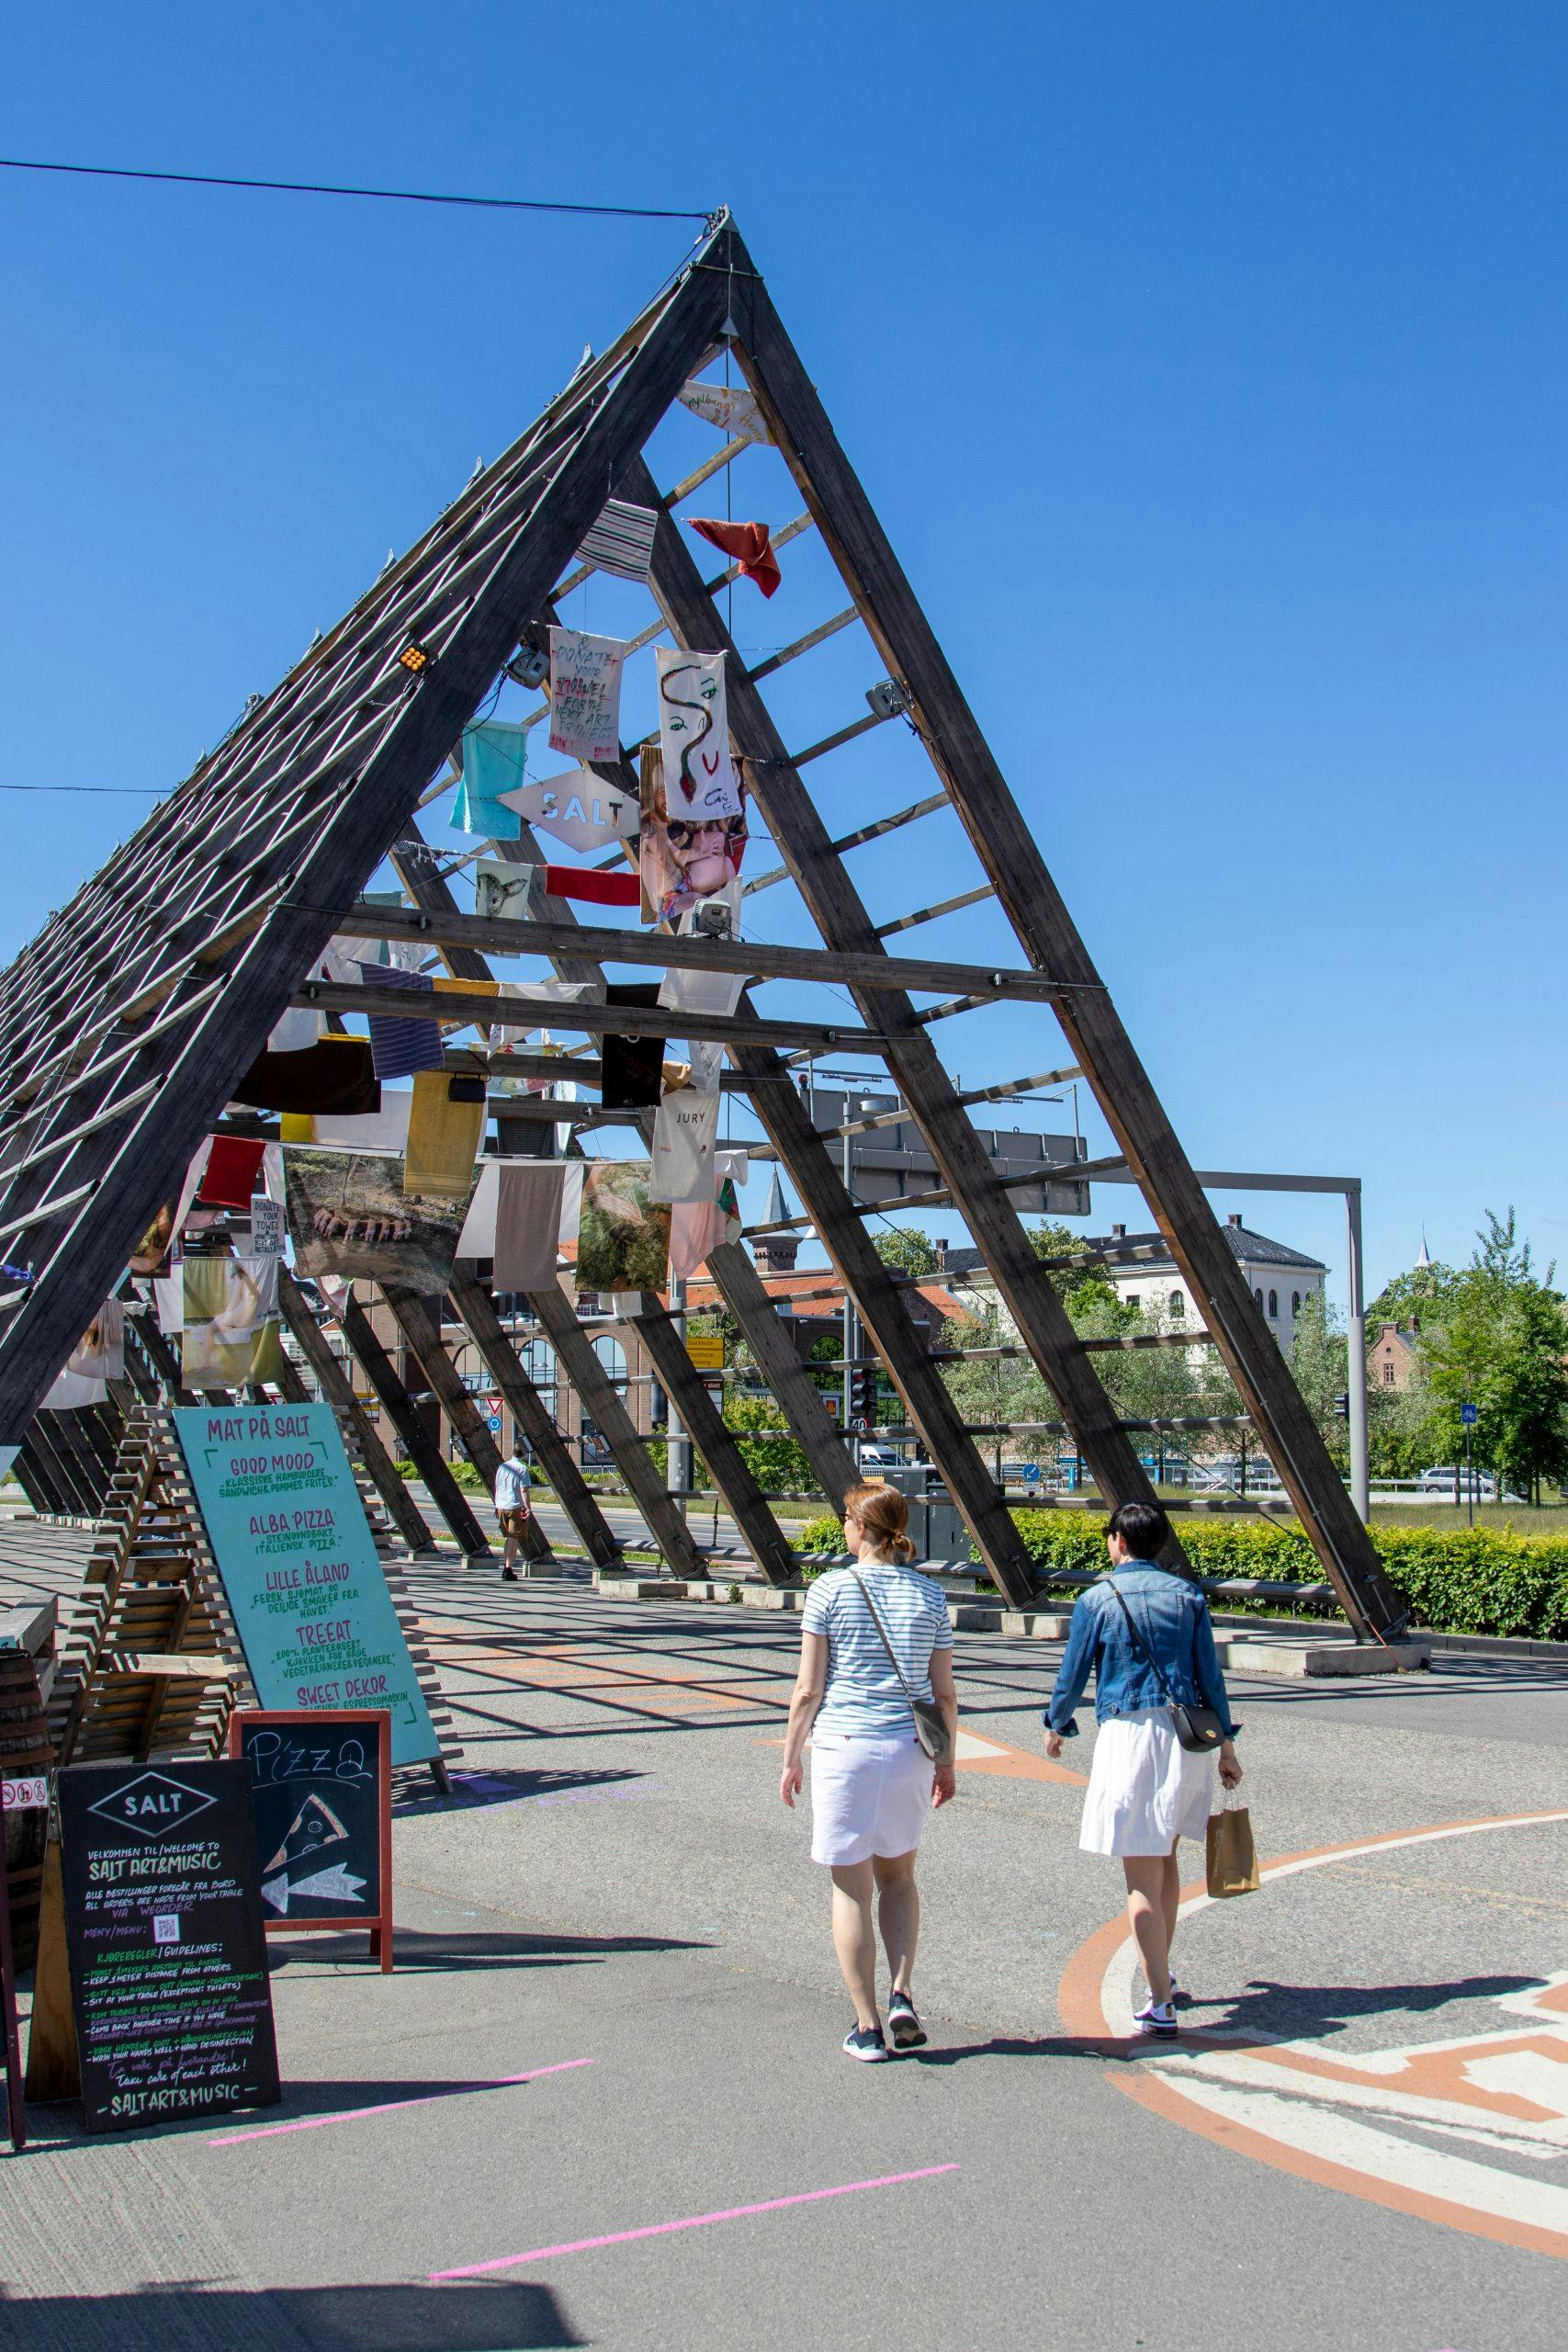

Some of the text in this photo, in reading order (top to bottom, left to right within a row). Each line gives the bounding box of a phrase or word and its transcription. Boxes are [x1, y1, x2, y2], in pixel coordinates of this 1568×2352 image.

[542, 792, 624, 827] SALT
[676, 1113, 705, 1124] JURY
[254, 1202, 281, 1212] DONATE
[263, 1212, 278, 1220] YOUR
[208, 1409, 310, 1442] MAT PÅ SALT
[852, 1419, 866, 1430] 40
[230, 1452, 314, 1476] GOOD MOOD
[249, 1509, 335, 1535] ALBA PIZZA
[255, 1540, 305, 1555] ITALIENSK
[265, 1560, 349, 1590] LILLE ÅLAND
[288, 1586, 323, 1600] SJØMAT
[302, 1592, 339, 1609] SMAKER
[342, 1589, 359, 1600] FRA
[296, 1620, 351, 1646] TREEAT
[302, 1639, 362, 1655] PLANTEBASERT
[287, 1652, 325, 1668] KJØKKEN
[328, 1650, 343, 1661] FOR
[297, 1674, 389, 1707] SWEET DEKOR
[125, 1792, 182, 1816] SALT
[88, 1848, 141, 1860] VELKOMMEN
[208, 1841, 220, 1850] TO
[89, 1859, 128, 1882] SALT
[85, 1890, 103, 1901] ALLE
[106, 1885, 158, 1898] BESTILLINGER
[193, 1882, 208, 1890] FRA
[210, 1879, 236, 1889] BORD
[85, 1888, 243, 1911] ALL ORDERS ARE MADE FROM YOUR TABLE
[111, 1901, 194, 1919] VIA WEORDER
[144, 1969, 179, 1979] DISTANCE
[181, 1966, 201, 1976] FROM
[203, 1963, 231, 1973] OTHERS
[106, 1996, 116, 2004] AT
[118, 1993, 136, 2003] YOUR
[137, 1990, 159, 2000] TABLE
[111, 2021, 131, 2031] BACK
[132, 2018, 163, 2028] ANOTHER
[163, 2016, 183, 2025] TIME
[184, 2015, 192, 2023] IF
[193, 2013, 206, 2021] YOU
[208, 2010, 227, 2020] HAVE
[112, 2051, 129, 2060] YOUR
[130, 2047, 152, 2057] HANDS
[154, 2045, 174, 2055] WELL
[180, 2042, 198, 2052] HAND
[147, 2071, 168, 2085] care
[170, 2067, 184, 2086] of
[182, 2067, 207, 2080] each
